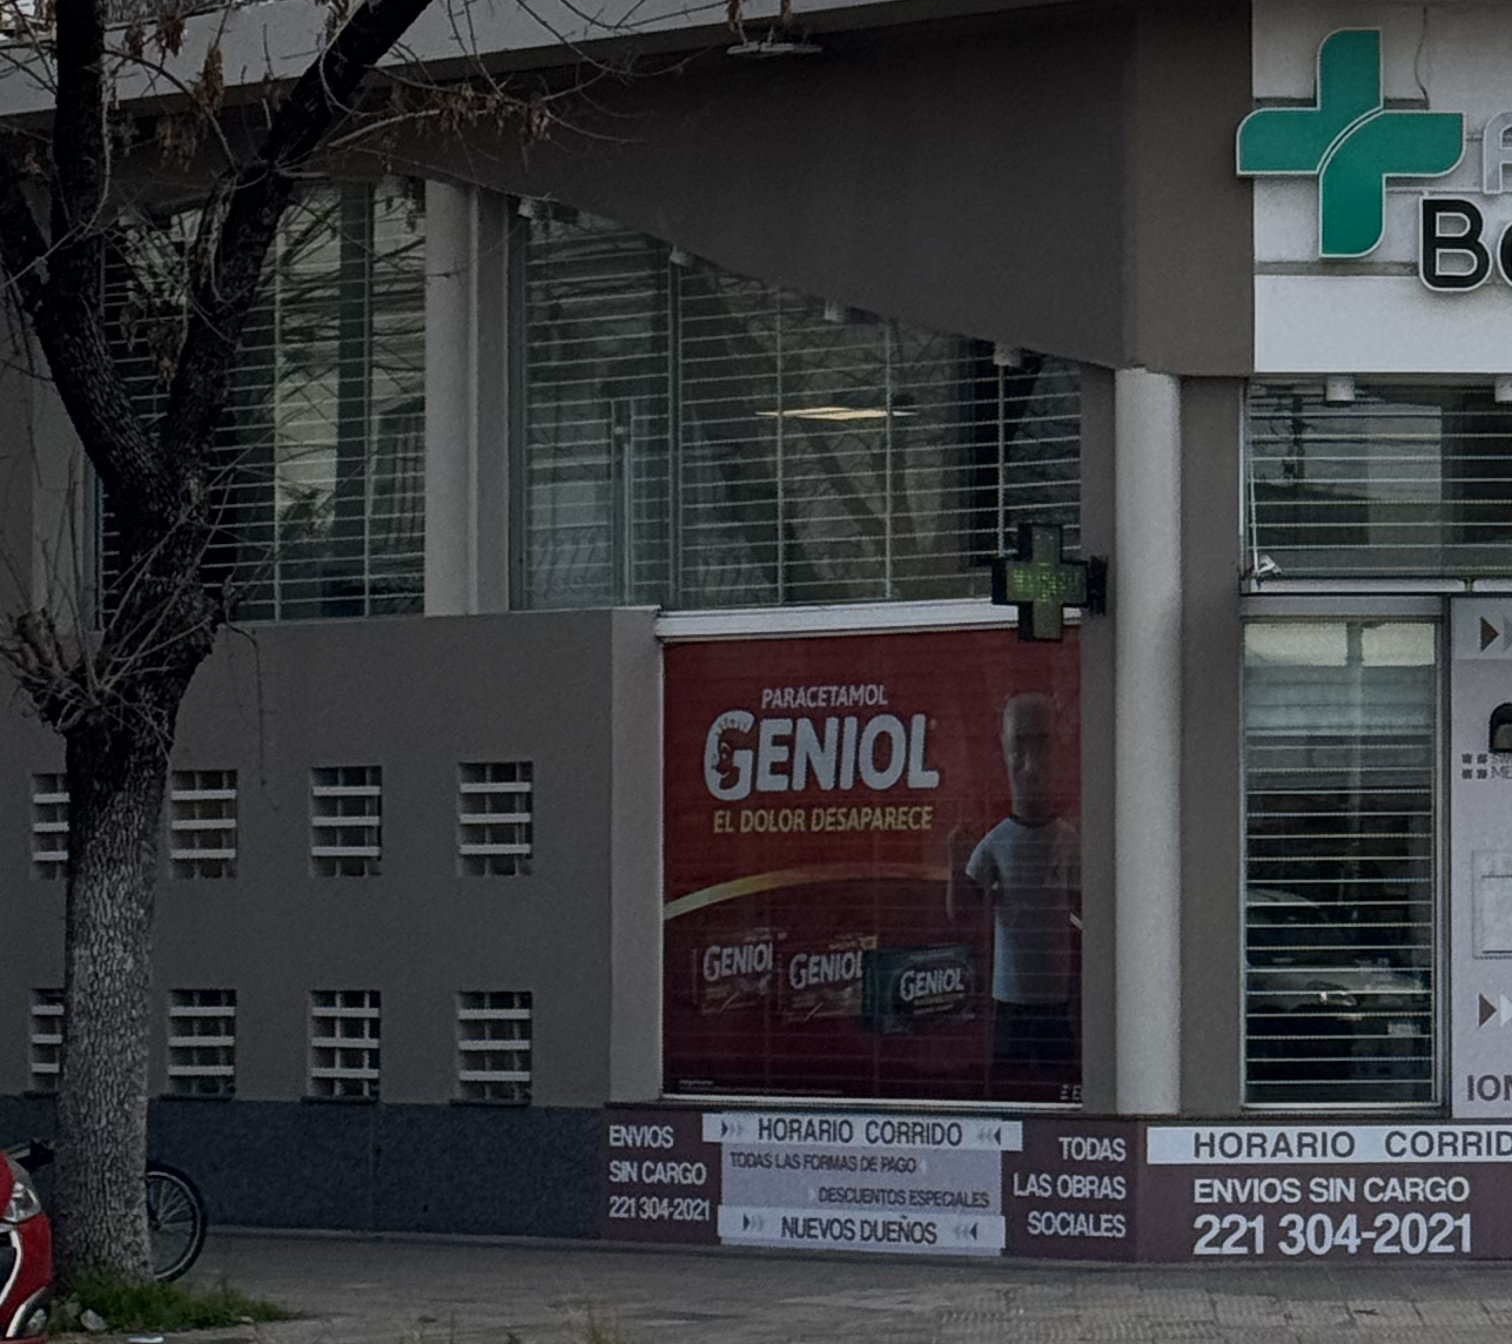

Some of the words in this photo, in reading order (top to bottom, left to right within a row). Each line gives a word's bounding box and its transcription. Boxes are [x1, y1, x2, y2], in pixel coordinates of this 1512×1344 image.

[761, 684, 889, 709] PARACETAMOL
[704, 709, 940, 801] GENIOL
[713, 809, 735, 833] EL
[740, 808, 806, 833] DOLOR
[811, 806, 934, 831] DESAPARECE
[900, 968, 965, 1001] GENIOL
[608, 1124, 674, 1149] ENVIOS
[758, 1117, 854, 1144] HORARIO
[865, 1119, 963, 1147] CORRIDO
[1193, 1130, 1356, 1158] HORARIO
[1059, 1136, 1127, 1162] TODAS
[608, 1161, 638, 1185] SIN
[641, 1161, 707, 1186] CARGO
[730, 1151, 774, 1169] TODAS
[774, 1152, 801, 1170] LAS
[803, 1154, 857, 1173] FORMAS
[860, 1156, 880, 1173] DE
[881, 1156, 917, 1175] PAGO
[818, 1185, 907, 1207] DESCUENTOS
[908, 1188, 990, 1208] ESPECIALES
[1013, 1172, 1053, 1198] LAS
[1056, 1173, 1127, 1199] OBRAS
[1193, 1177, 1302, 1204] ENVIOS
[1308, 1176, 1356, 1204] SIN
[1363, 1176, 1470, 1203] CARGO
[608, 1195, 637, 1220] 221
[638, 1197, 710, 1222] 304-2021
[781, 1216, 858, 1242] NUEVOS
[860, 1213, 938, 1245] DUEÑOS
[1027, 1210, 1127, 1238] SOCIALES
[1193, 1213, 1265, 1256] 221
[1278, 1212, 1472, 1255] 304-2021
